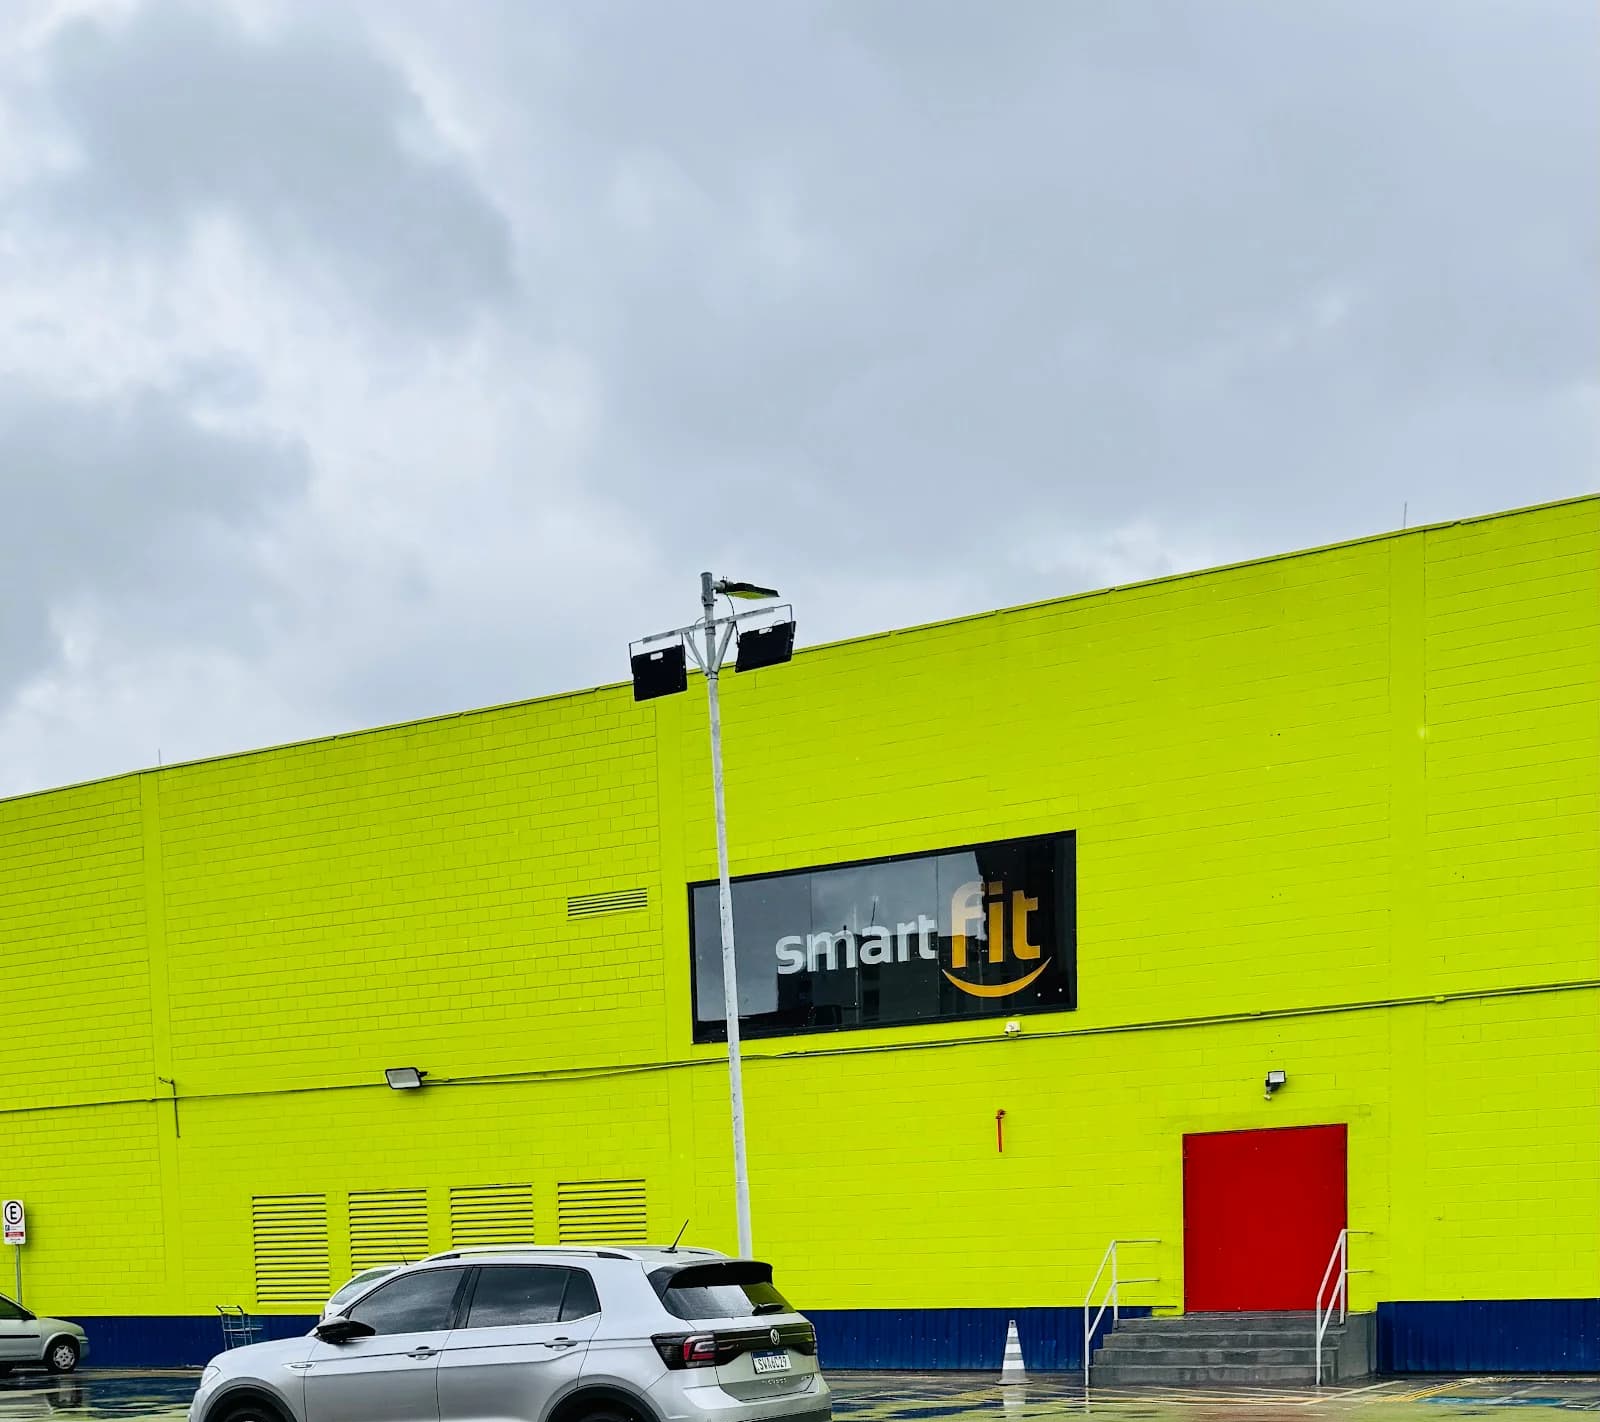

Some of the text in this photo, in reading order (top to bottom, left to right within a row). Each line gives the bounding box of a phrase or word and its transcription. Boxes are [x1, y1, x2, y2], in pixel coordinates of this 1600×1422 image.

[776, 880, 1041, 975] smart fit
[10, 1205, 17, 1220] E
